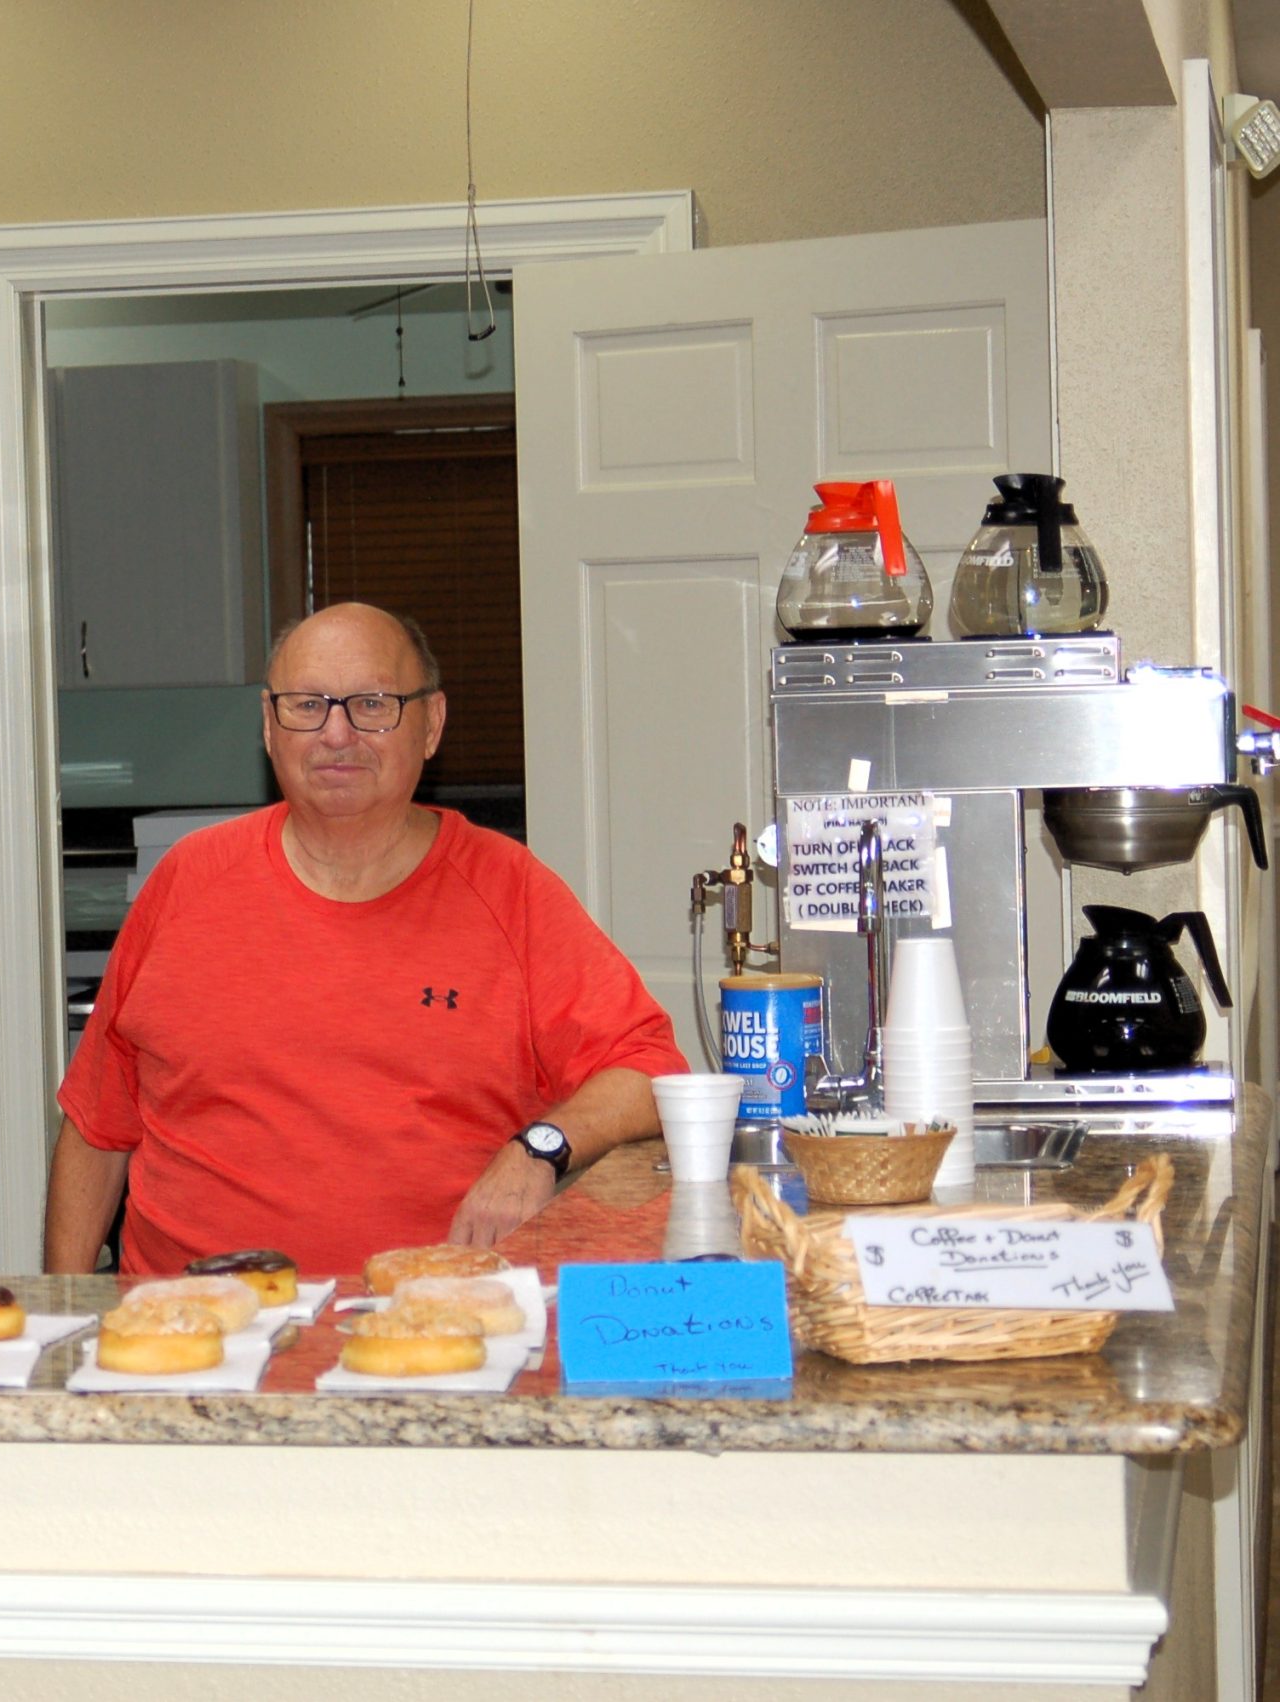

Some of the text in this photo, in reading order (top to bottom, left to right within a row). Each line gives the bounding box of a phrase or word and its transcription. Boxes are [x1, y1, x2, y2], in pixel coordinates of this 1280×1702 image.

[841, 795, 926, 810] IMPORTANT
[793, 840, 915, 855] TURN OF ACK
[793, 862, 848, 876] SWITCH
[793, 884, 811, 896] OF
[816, 882, 860, 895] COFFE
[808, 903, 859, 915] DOUBL
[884, 900, 923, 913] HECK)
[1073, 990, 1162, 1004] BLOOMFIELD
[723, 1034, 779, 1060] OUSE
[911, 1227, 976, 1247] Coffee
[606, 1274, 692, 1297] Donut
[1052, 1272, 1110, 1296] Thank
